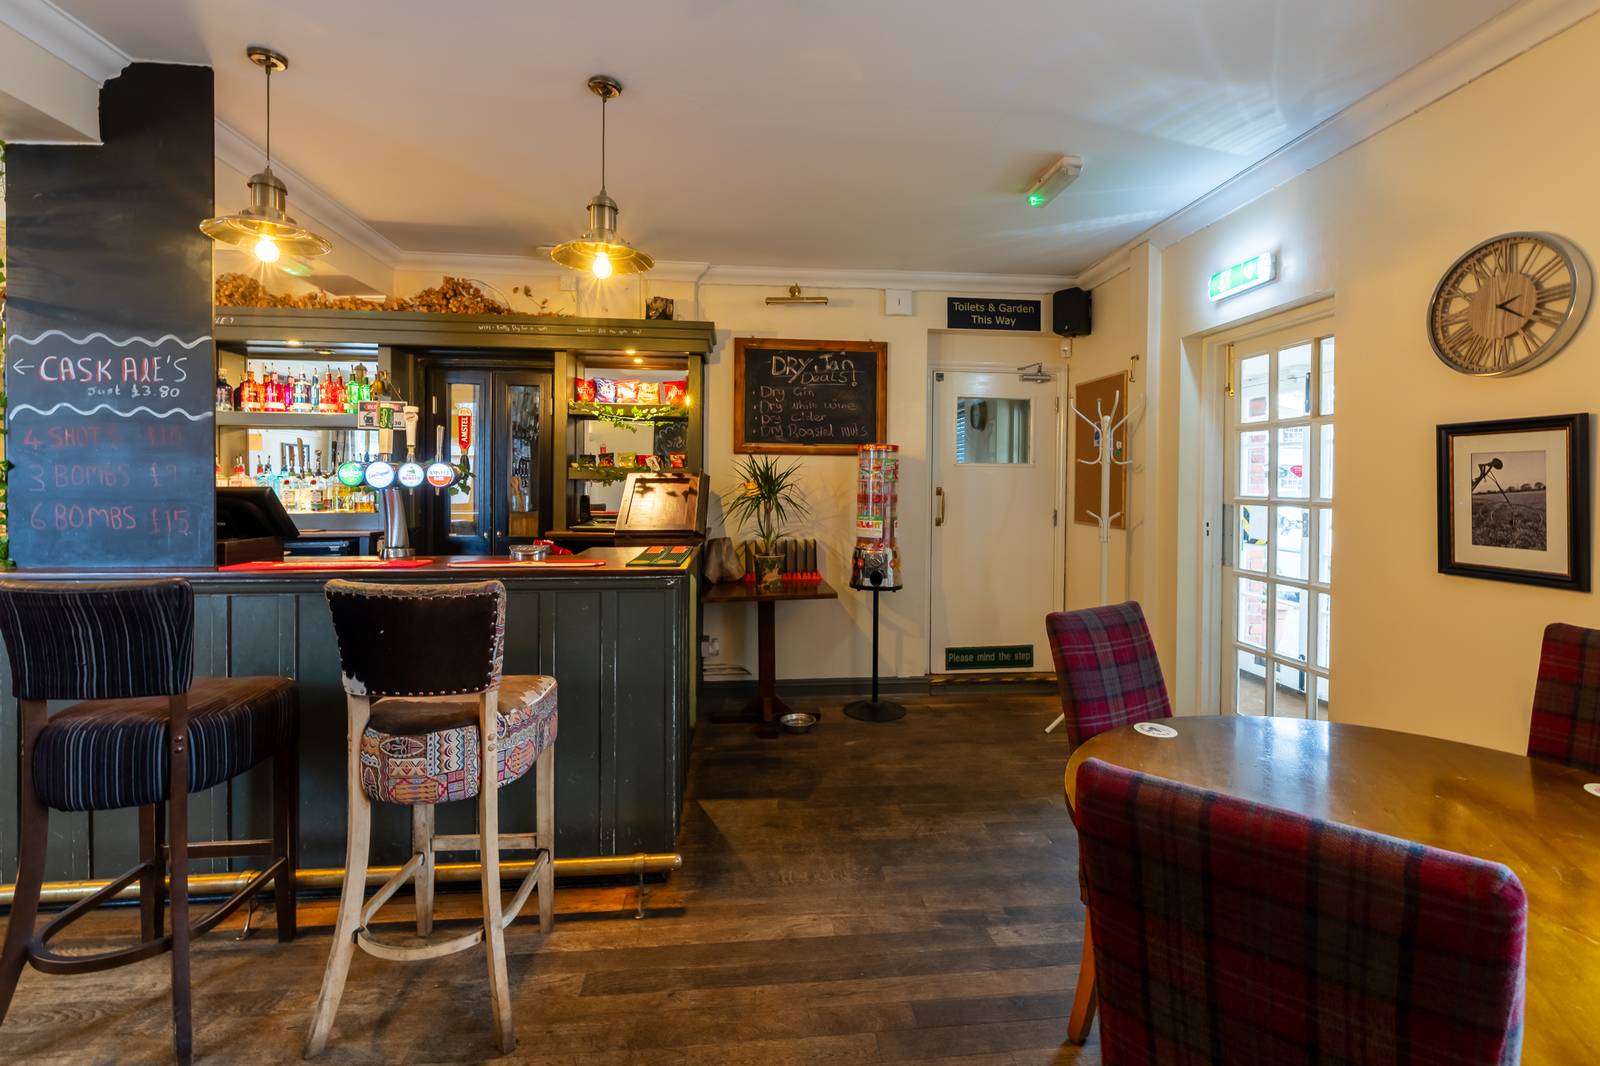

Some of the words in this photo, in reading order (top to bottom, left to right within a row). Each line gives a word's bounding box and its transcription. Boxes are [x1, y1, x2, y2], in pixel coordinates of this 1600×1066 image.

[953, 301, 985, 313] Toilets
[988, 303, 996, 312] &
[998, 303, 1035, 313] Garden
[971, 315, 993, 325] This
[995, 316, 1017, 327] Way
[39, 355, 113, 383] CASK
[771, 355, 814, 383] DRY
[760, 385, 785, 402] Dry
[22, 427, 42, 451] 4
[461, 415, 469, 443] AMSTEL
[28, 463, 47, 492] 3
[54, 462, 131, 490] BOMBS
[30, 502, 47, 531] 6
[54, 502, 138, 532] BOMBS
[948, 652, 975, 663] Please
[977, 651, 996, 661] mind
[998, 652, 1012, 661] the
[1014, 651, 1031, 663] step
